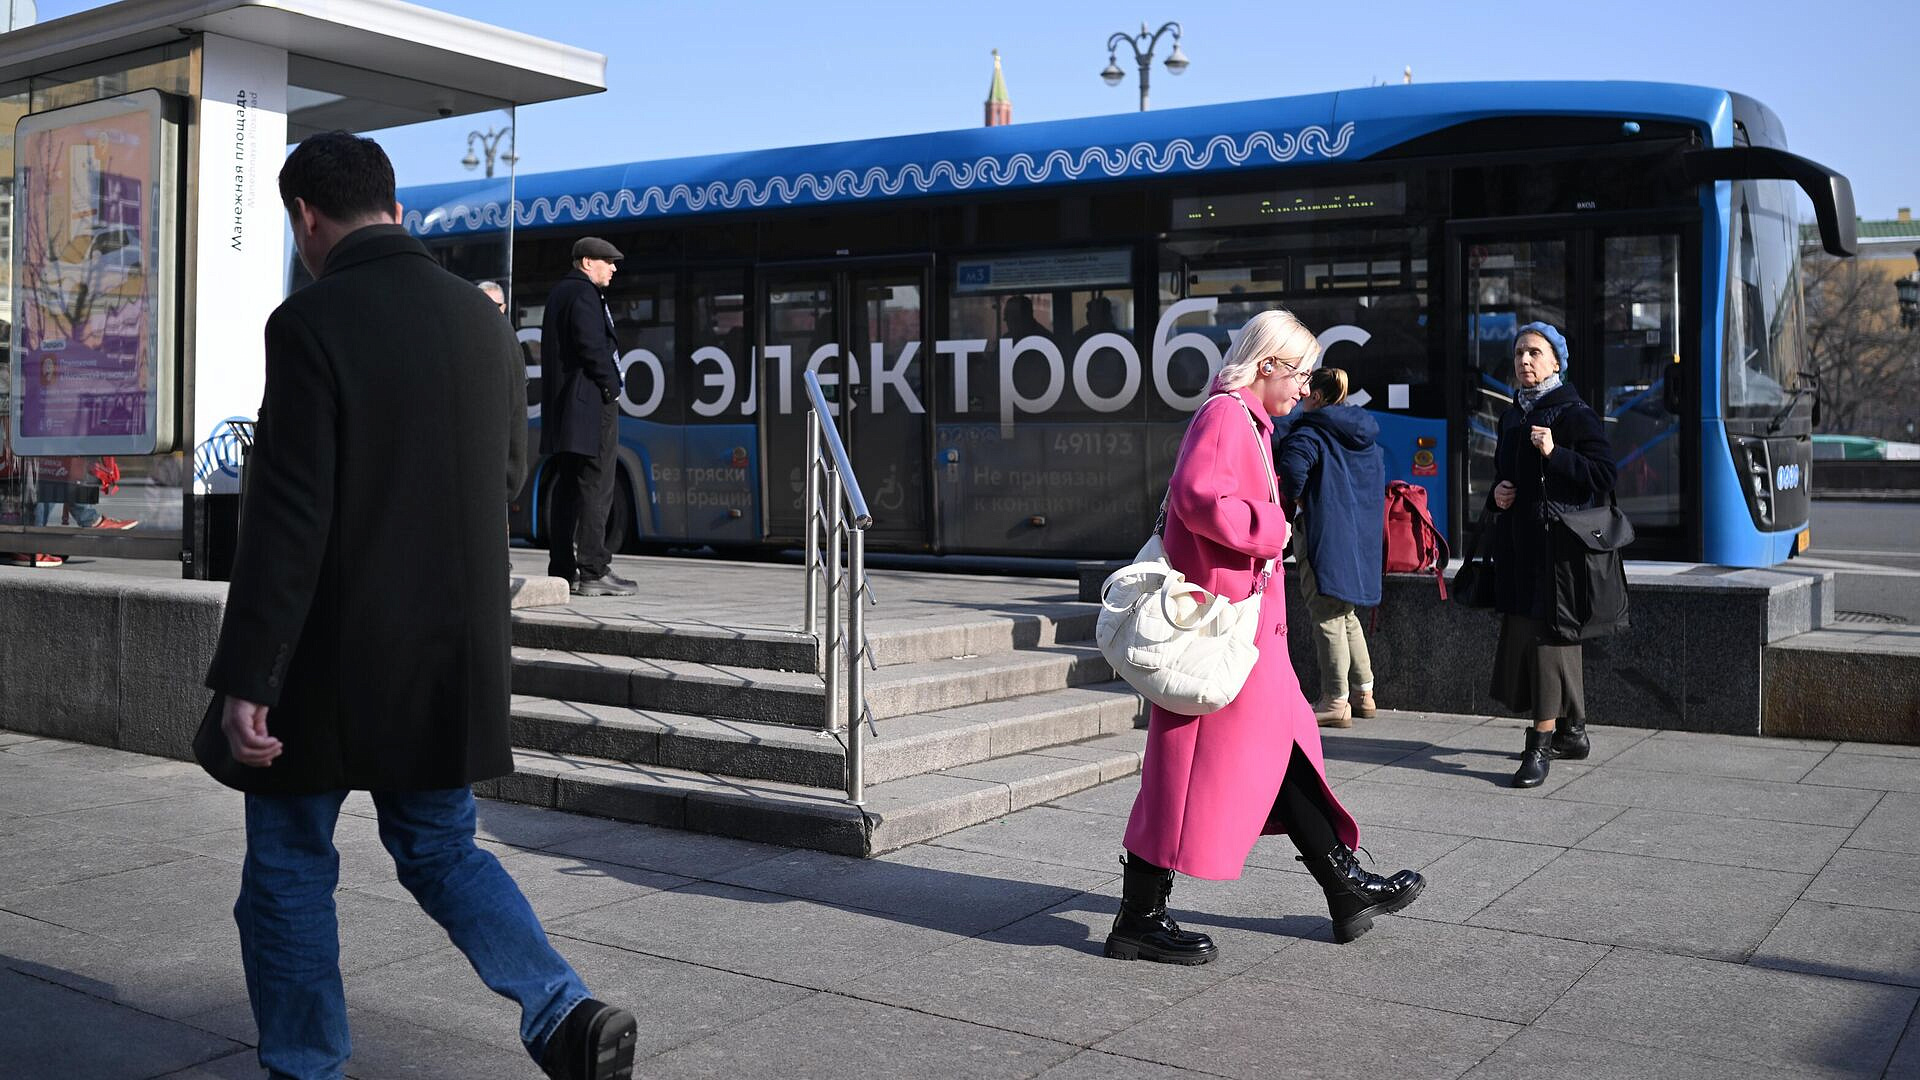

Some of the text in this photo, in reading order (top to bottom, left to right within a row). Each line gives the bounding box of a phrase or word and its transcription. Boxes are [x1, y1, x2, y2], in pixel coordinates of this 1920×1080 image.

[231, 89, 247, 252] Манежная площадь
[690, 297, 1410, 439] электробс.
[1054, 433, 1133, 455] 491193
[651, 463, 745, 485] Без тряски
[974, 466, 1112, 490] Не привязан
[666, 487, 752, 509] вибраций
[975, 499, 985, 512] к
[992, 496, 1117, 513] контактной
